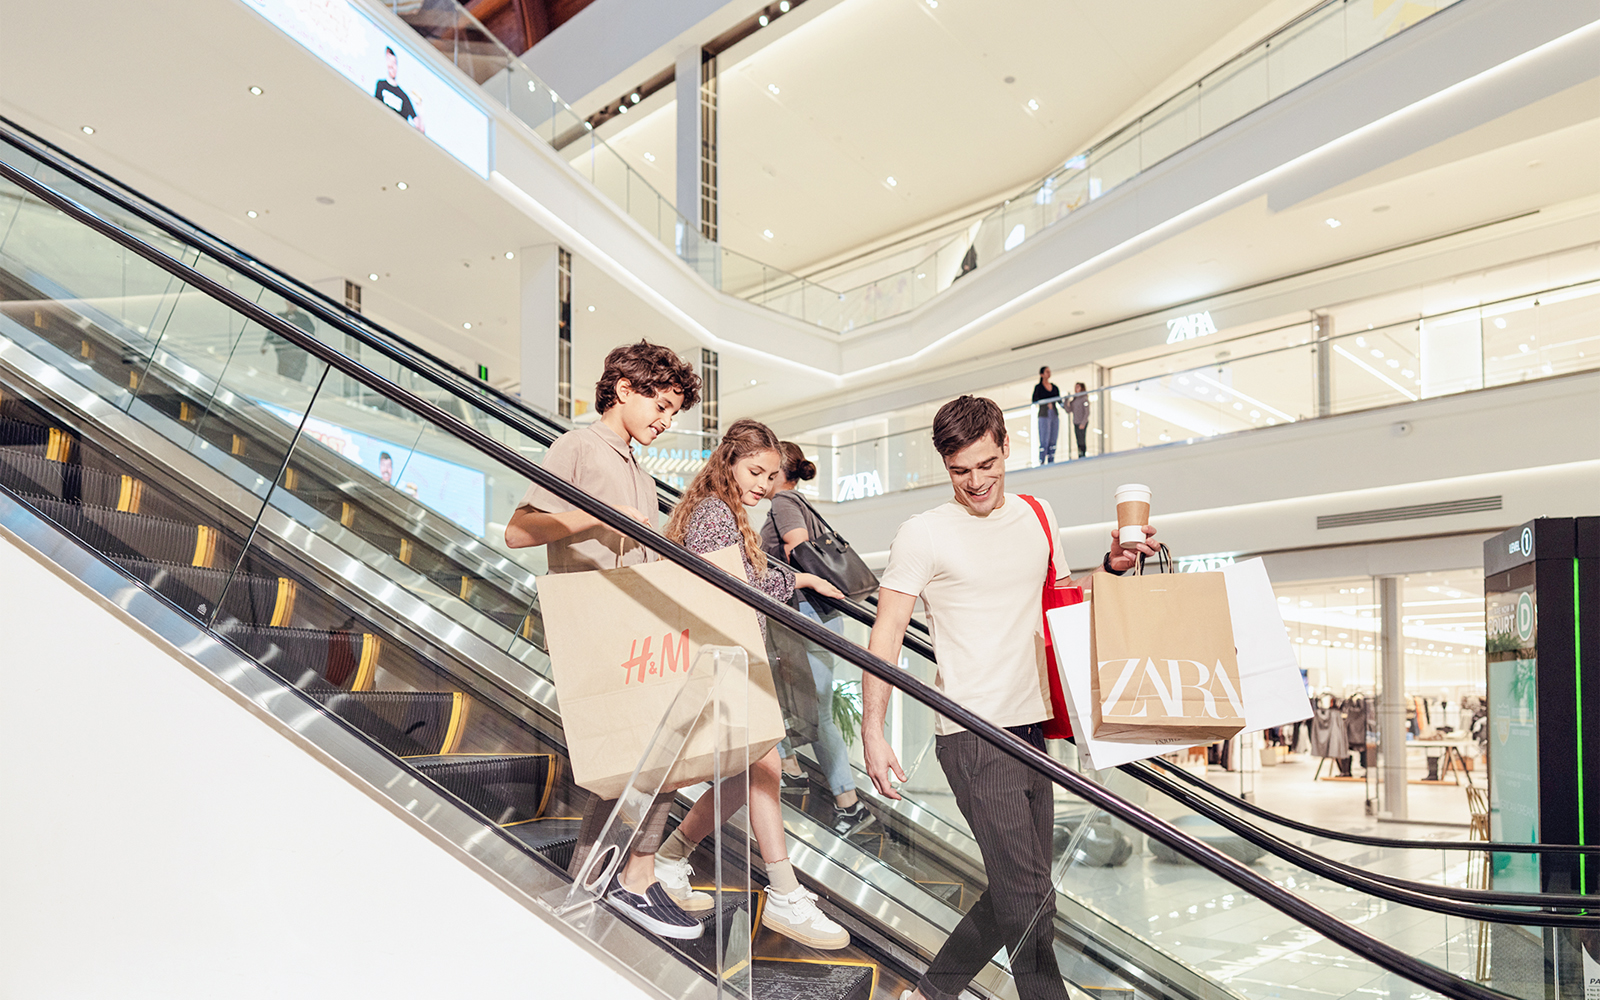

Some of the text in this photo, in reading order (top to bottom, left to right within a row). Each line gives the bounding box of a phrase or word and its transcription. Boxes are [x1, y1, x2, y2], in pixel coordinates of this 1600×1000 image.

[1166, 310, 1218, 345] ZARA
[1509, 533, 1529, 553] LEVEL 1
[1487, 614, 1515, 636] COURT
[1520, 603, 1530, 632] D
[620, 628, 690, 685] H&M
[1098, 656, 1246, 720] ZARA
